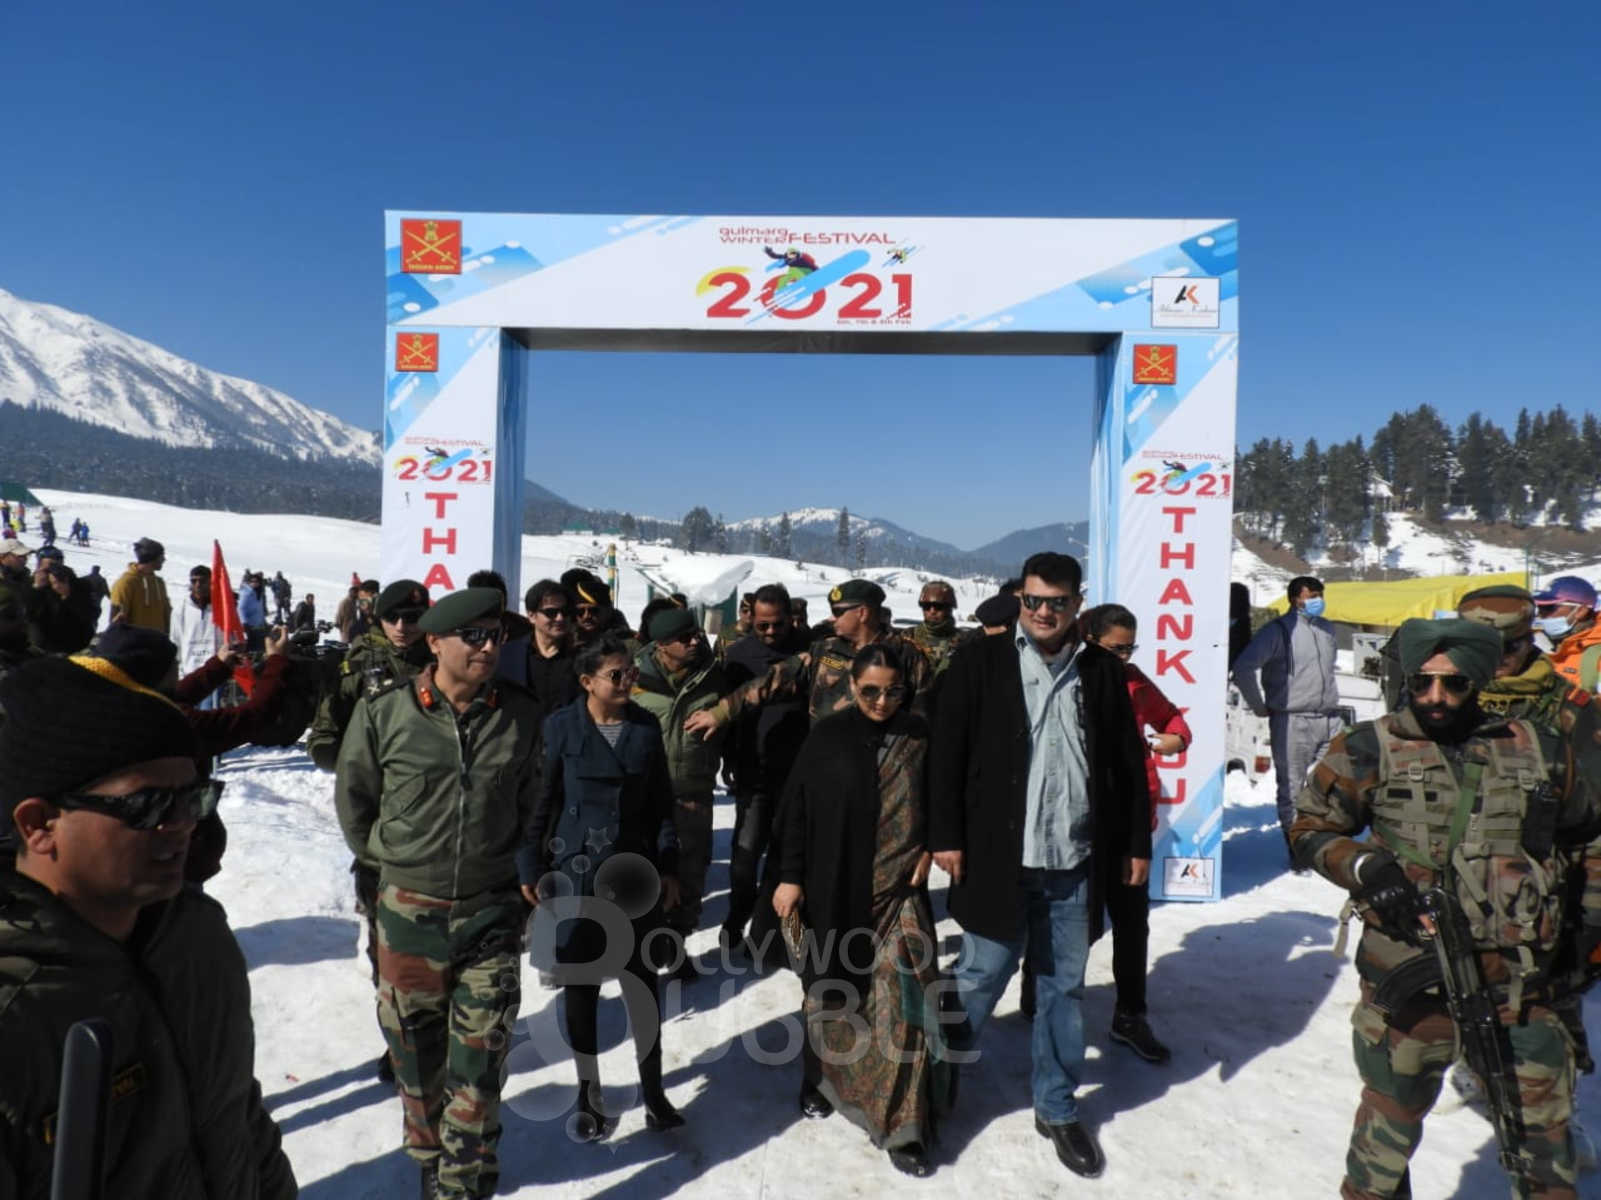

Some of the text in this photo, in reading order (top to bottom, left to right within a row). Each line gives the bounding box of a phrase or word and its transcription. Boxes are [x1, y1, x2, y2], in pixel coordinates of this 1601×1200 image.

[788, 232, 896, 245] FESTIVAL
[706, 271, 913, 320] 2021
[398, 457, 492, 482] 2021
[1135, 471, 1231, 496] 2021
[422, 491, 459, 607] THA
[1155, 506, 1197, 685] THANK
